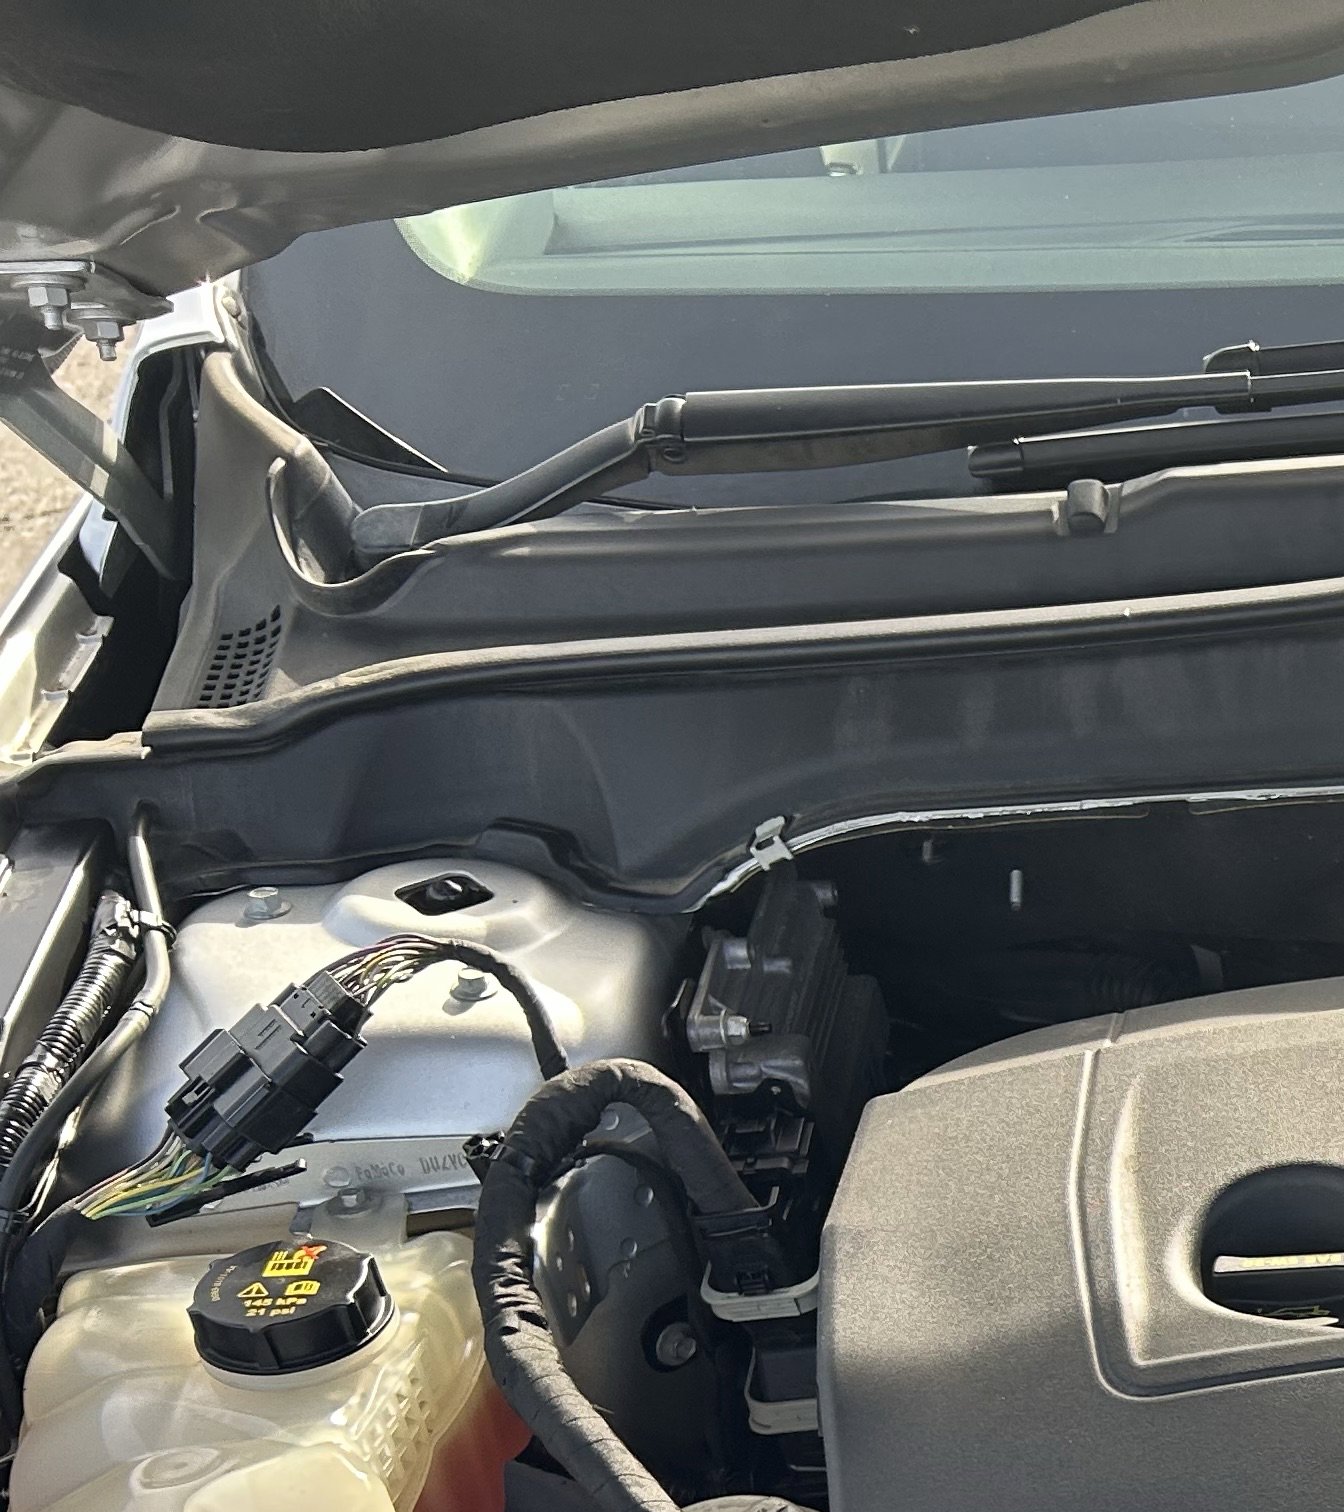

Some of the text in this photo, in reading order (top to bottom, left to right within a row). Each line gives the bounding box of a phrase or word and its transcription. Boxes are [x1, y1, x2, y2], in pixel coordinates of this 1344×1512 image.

[275, 1297, 307, 1305] kPa
[244, 1305, 296, 1316] 21 psi
